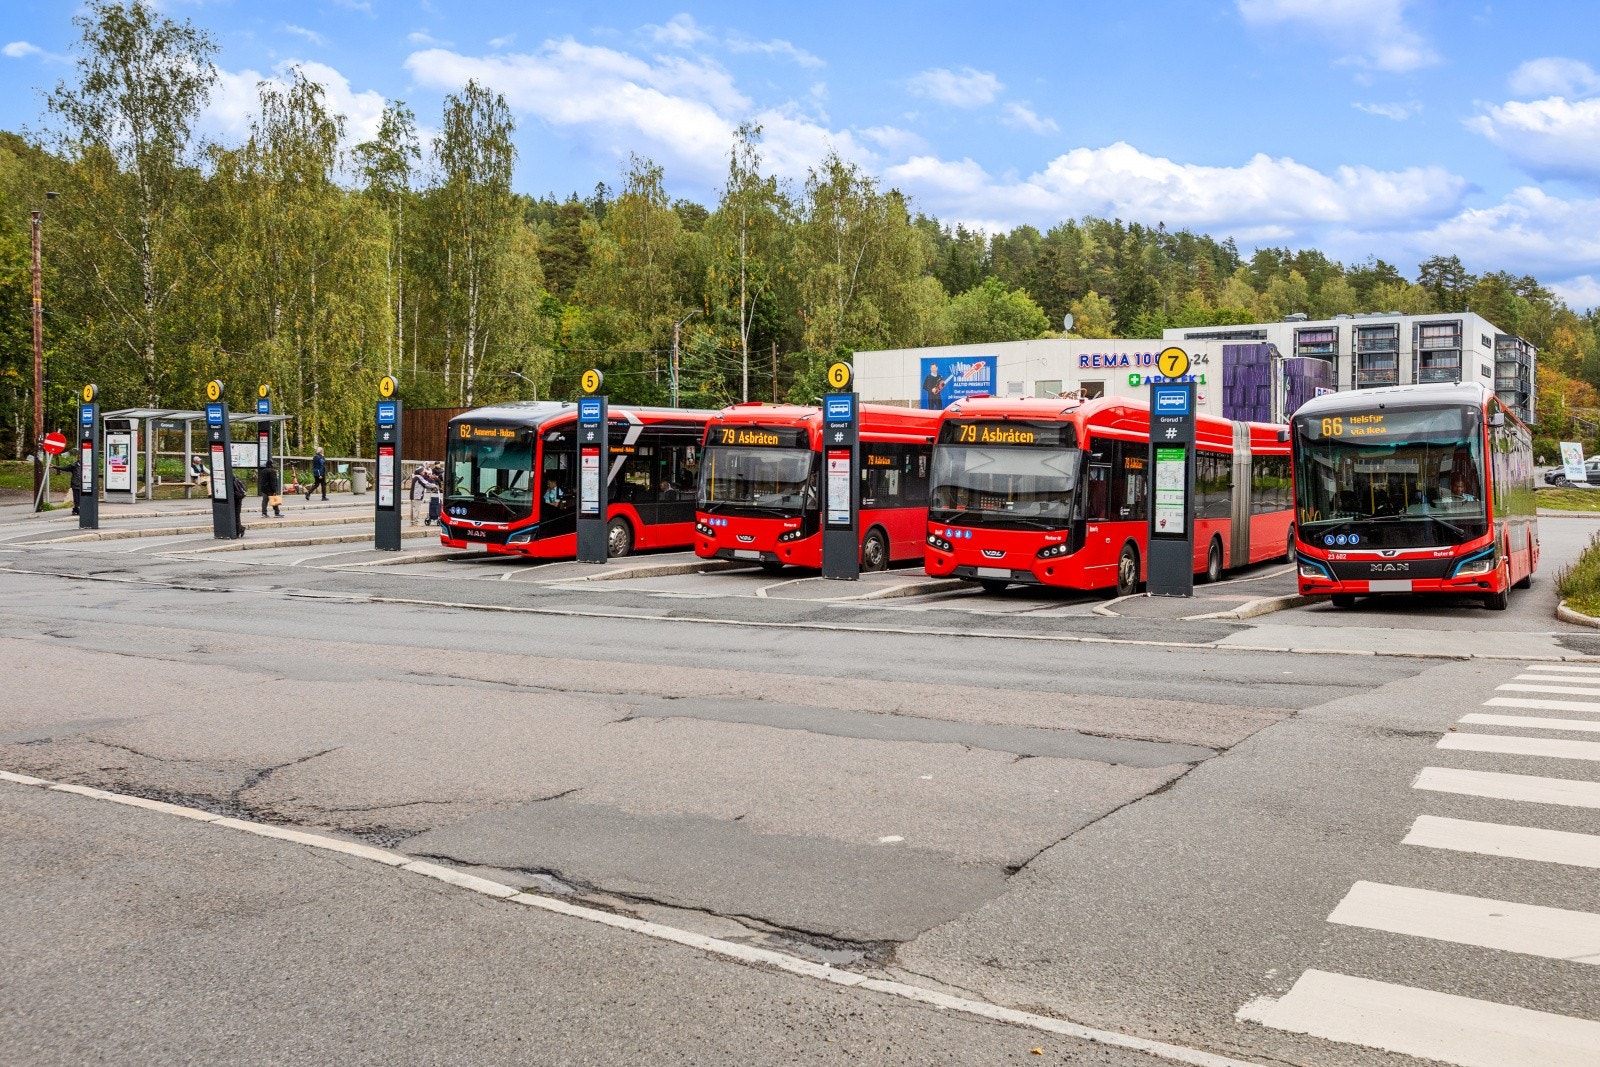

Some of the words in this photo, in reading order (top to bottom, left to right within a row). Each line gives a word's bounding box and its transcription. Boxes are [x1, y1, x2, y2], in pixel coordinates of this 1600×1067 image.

[1079, 354, 1130, 368] REMA
[1135, 352, 1160, 367] 100
[1168, 355, 1179, 371] 7
[587, 375, 594, 388] 5
[834, 368, 843, 382] 6
[1200, 373, 1207, 385] 1
[86, 388, 91, 398] 2
[211, 385, 216, 396] 3
[383, 381, 389, 392] 4
[460, 424, 471, 438] 62
[1321, 417, 1343, 437] 66
[1349, 414, 1384, 424] Helsfyr
[1350, 427, 1365, 436] via
[1367, 426, 1387, 435] Ikea
[722, 428, 735, 444] 79
[960, 424, 977, 442] 79
[467, 529, 487, 537] MAN
[1370, 562, 1410, 572] MAN
